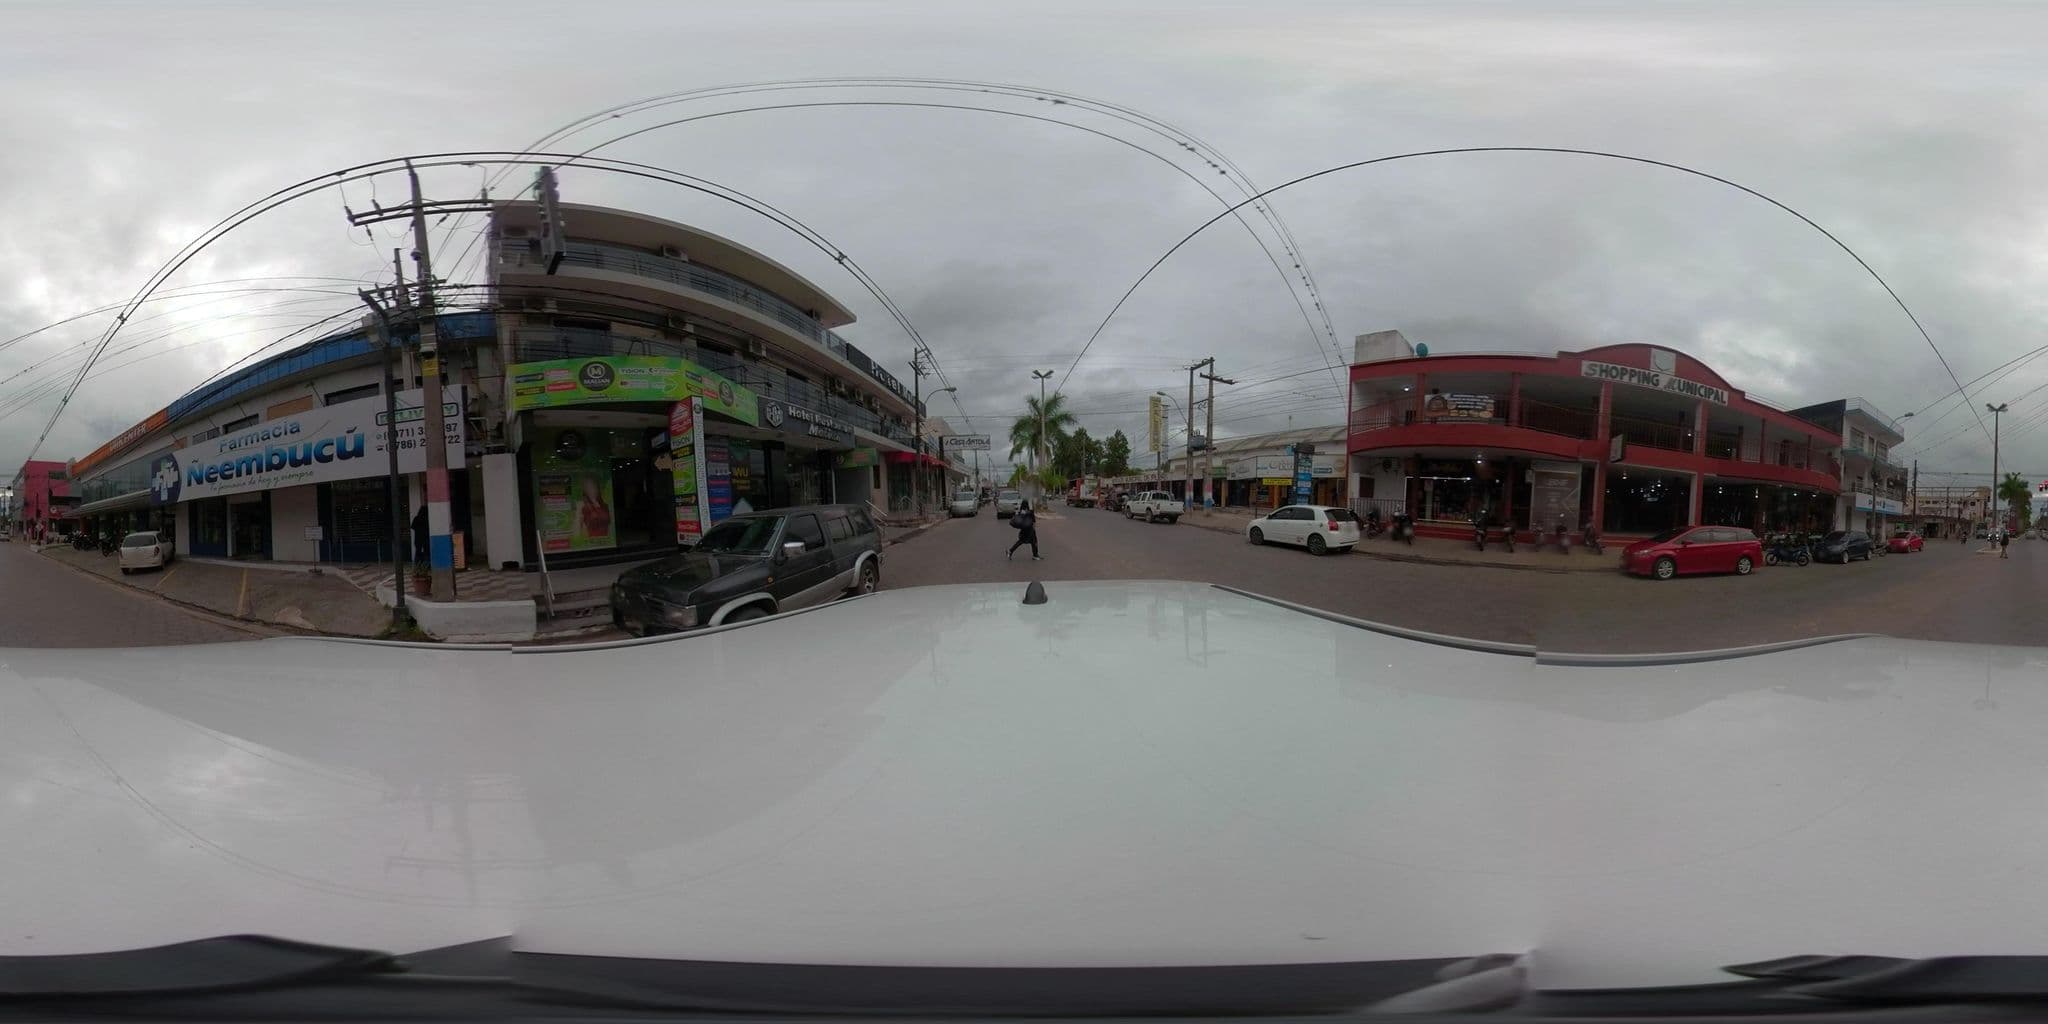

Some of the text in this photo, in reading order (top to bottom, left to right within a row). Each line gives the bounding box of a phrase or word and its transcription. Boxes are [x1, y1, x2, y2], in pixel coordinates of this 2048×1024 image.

[1583, 362, 1660, 387] SHOPPING
[788, 406, 813, 423] Hotel
[219, 420, 302, 453] Farmacia
[187, 426, 365, 487] Ñeembucú
[281, 471, 313, 482] siempre
